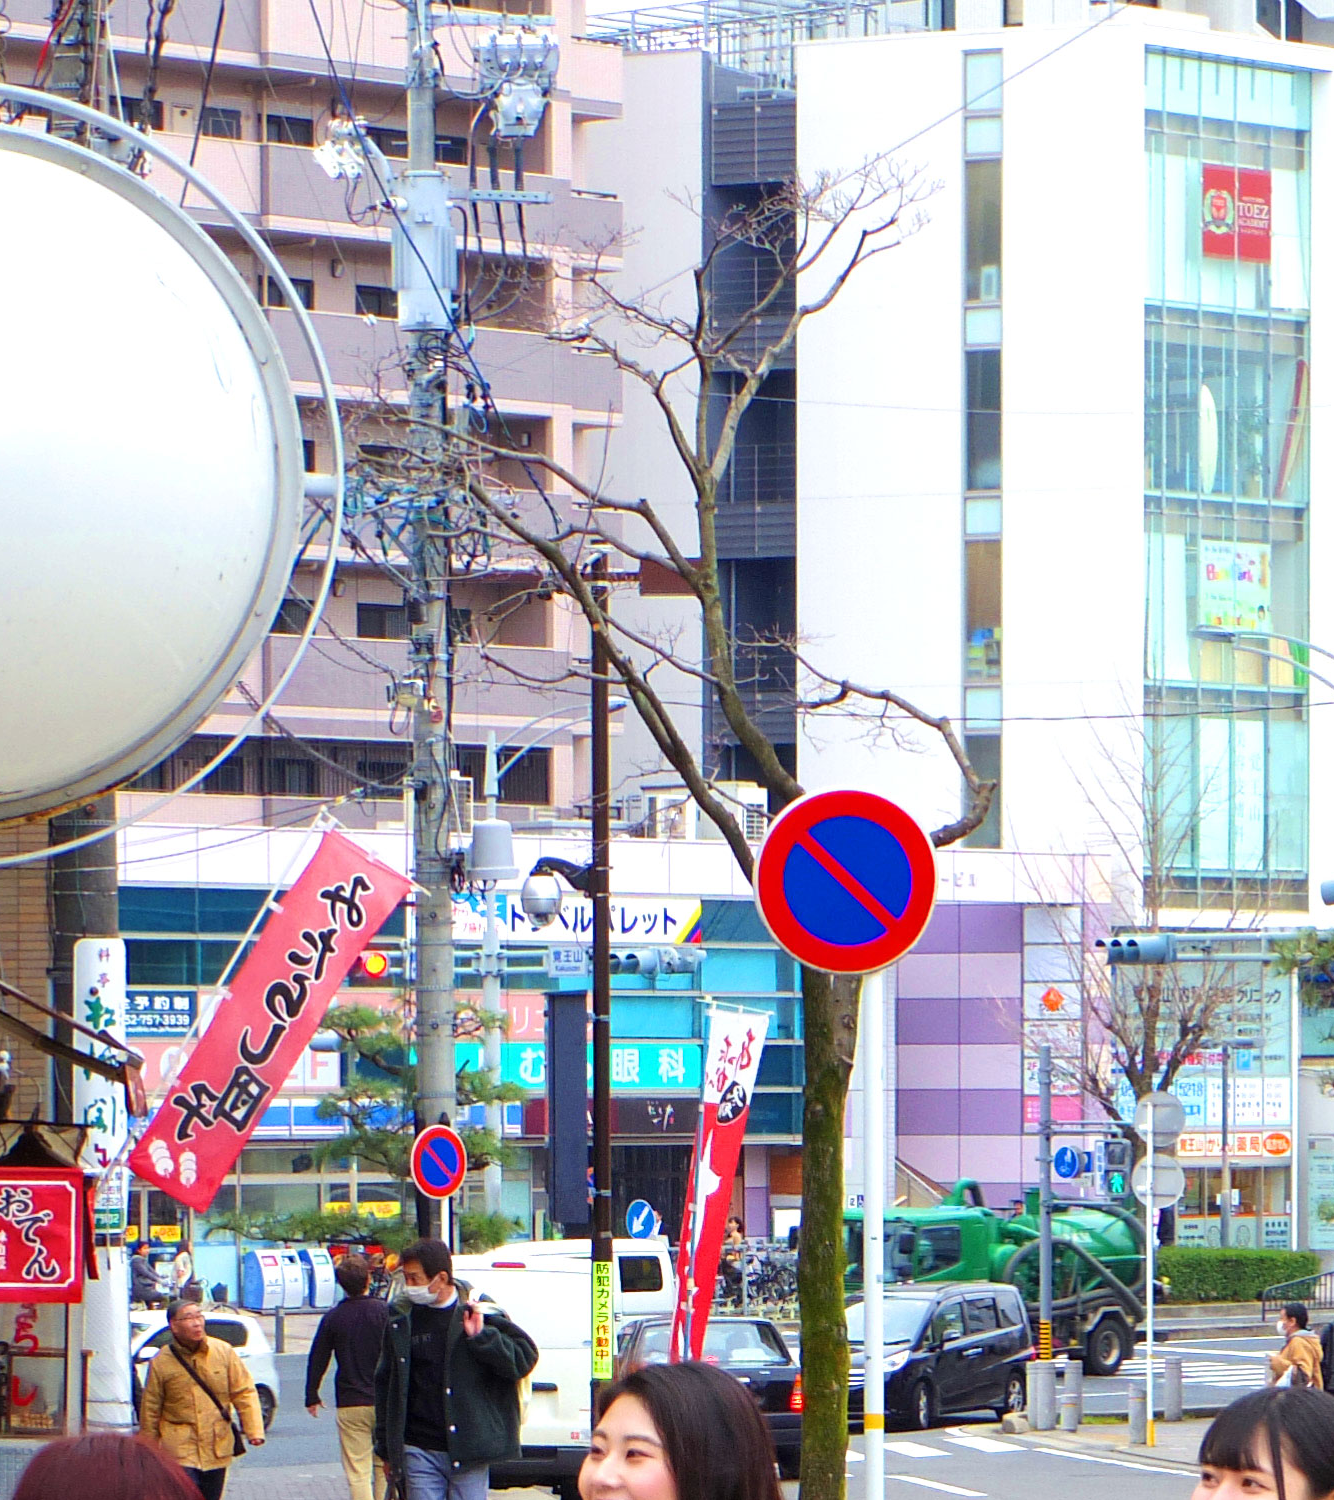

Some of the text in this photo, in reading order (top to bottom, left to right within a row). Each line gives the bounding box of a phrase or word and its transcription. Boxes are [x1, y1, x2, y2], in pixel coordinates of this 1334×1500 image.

[596, 1264, 610, 1360] 防犯カメラ作動中
